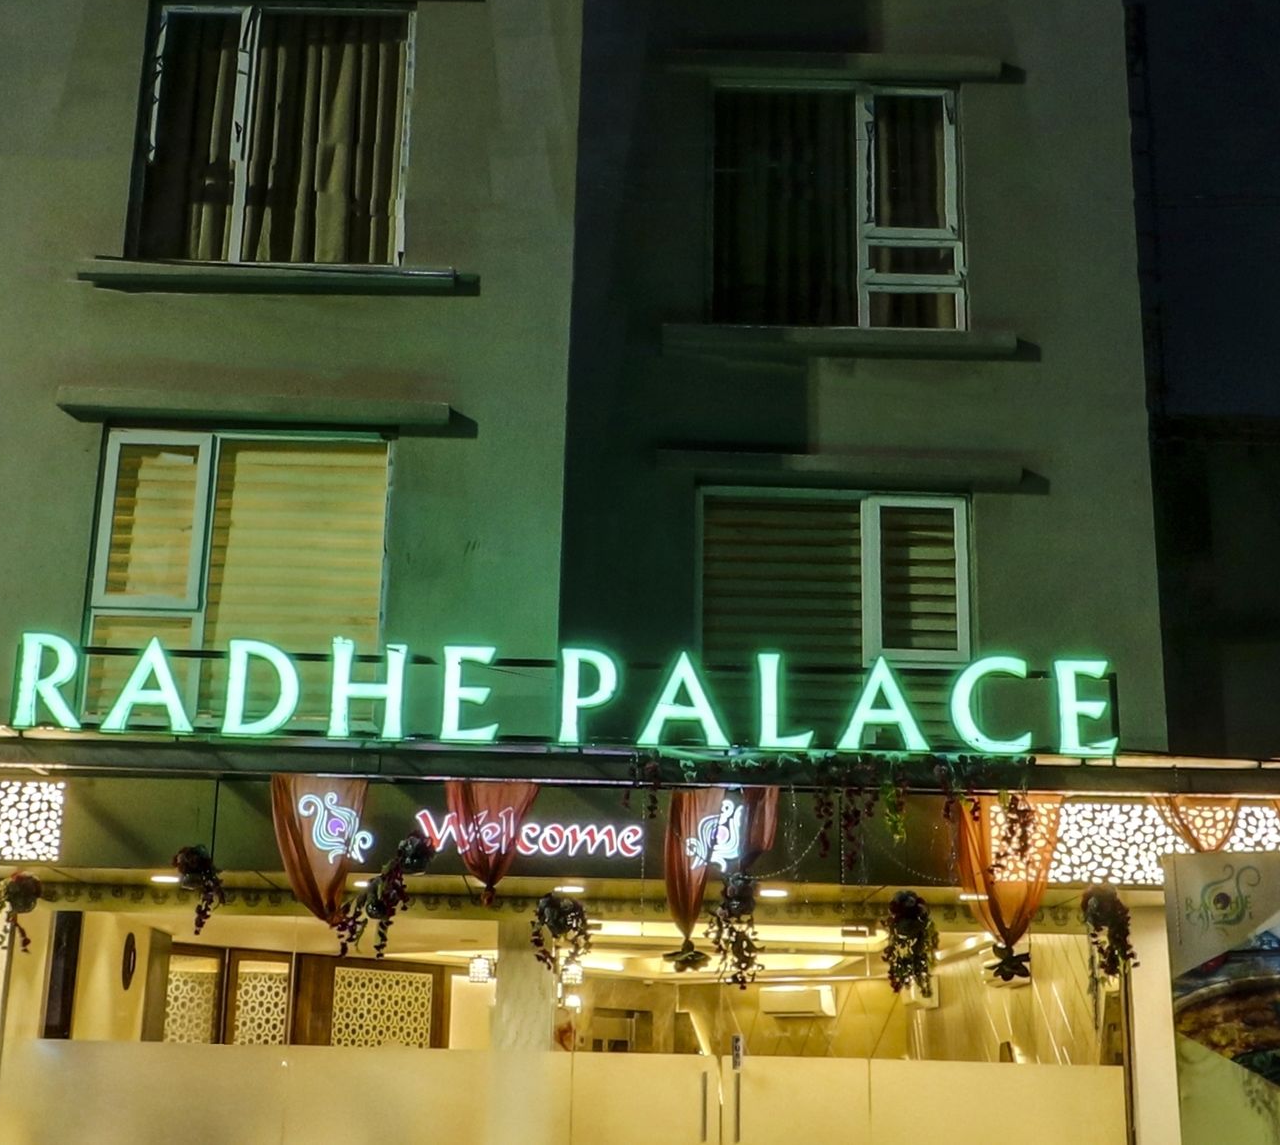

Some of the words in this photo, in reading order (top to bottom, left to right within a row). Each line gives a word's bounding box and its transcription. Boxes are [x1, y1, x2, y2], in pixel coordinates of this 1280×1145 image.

[12, 632, 500, 742] RADHE
[557, 648, 1119, 754] PALACE
[416, 807, 644, 857] Welcome
